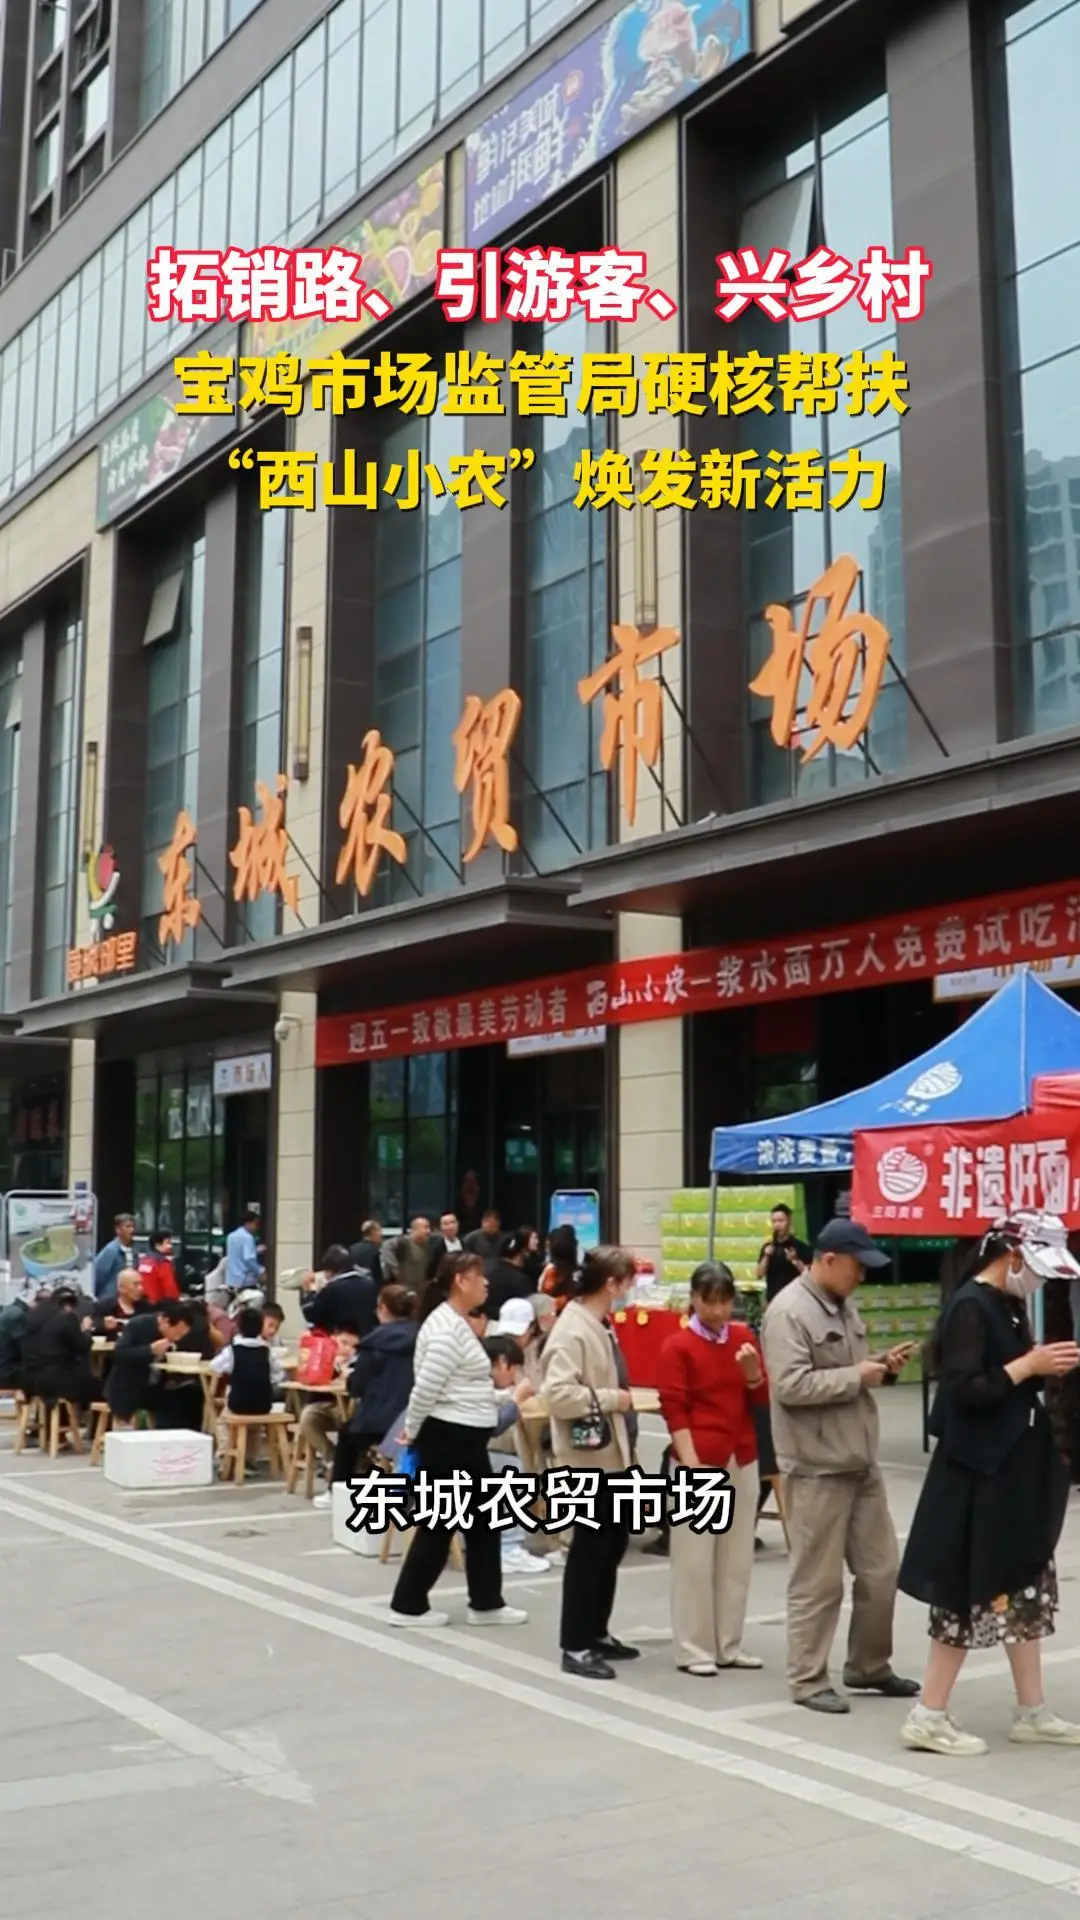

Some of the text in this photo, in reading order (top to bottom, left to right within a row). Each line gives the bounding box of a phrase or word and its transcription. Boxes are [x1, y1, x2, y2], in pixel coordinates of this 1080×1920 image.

[157, 553, 890, 946] 东城农贸市场
